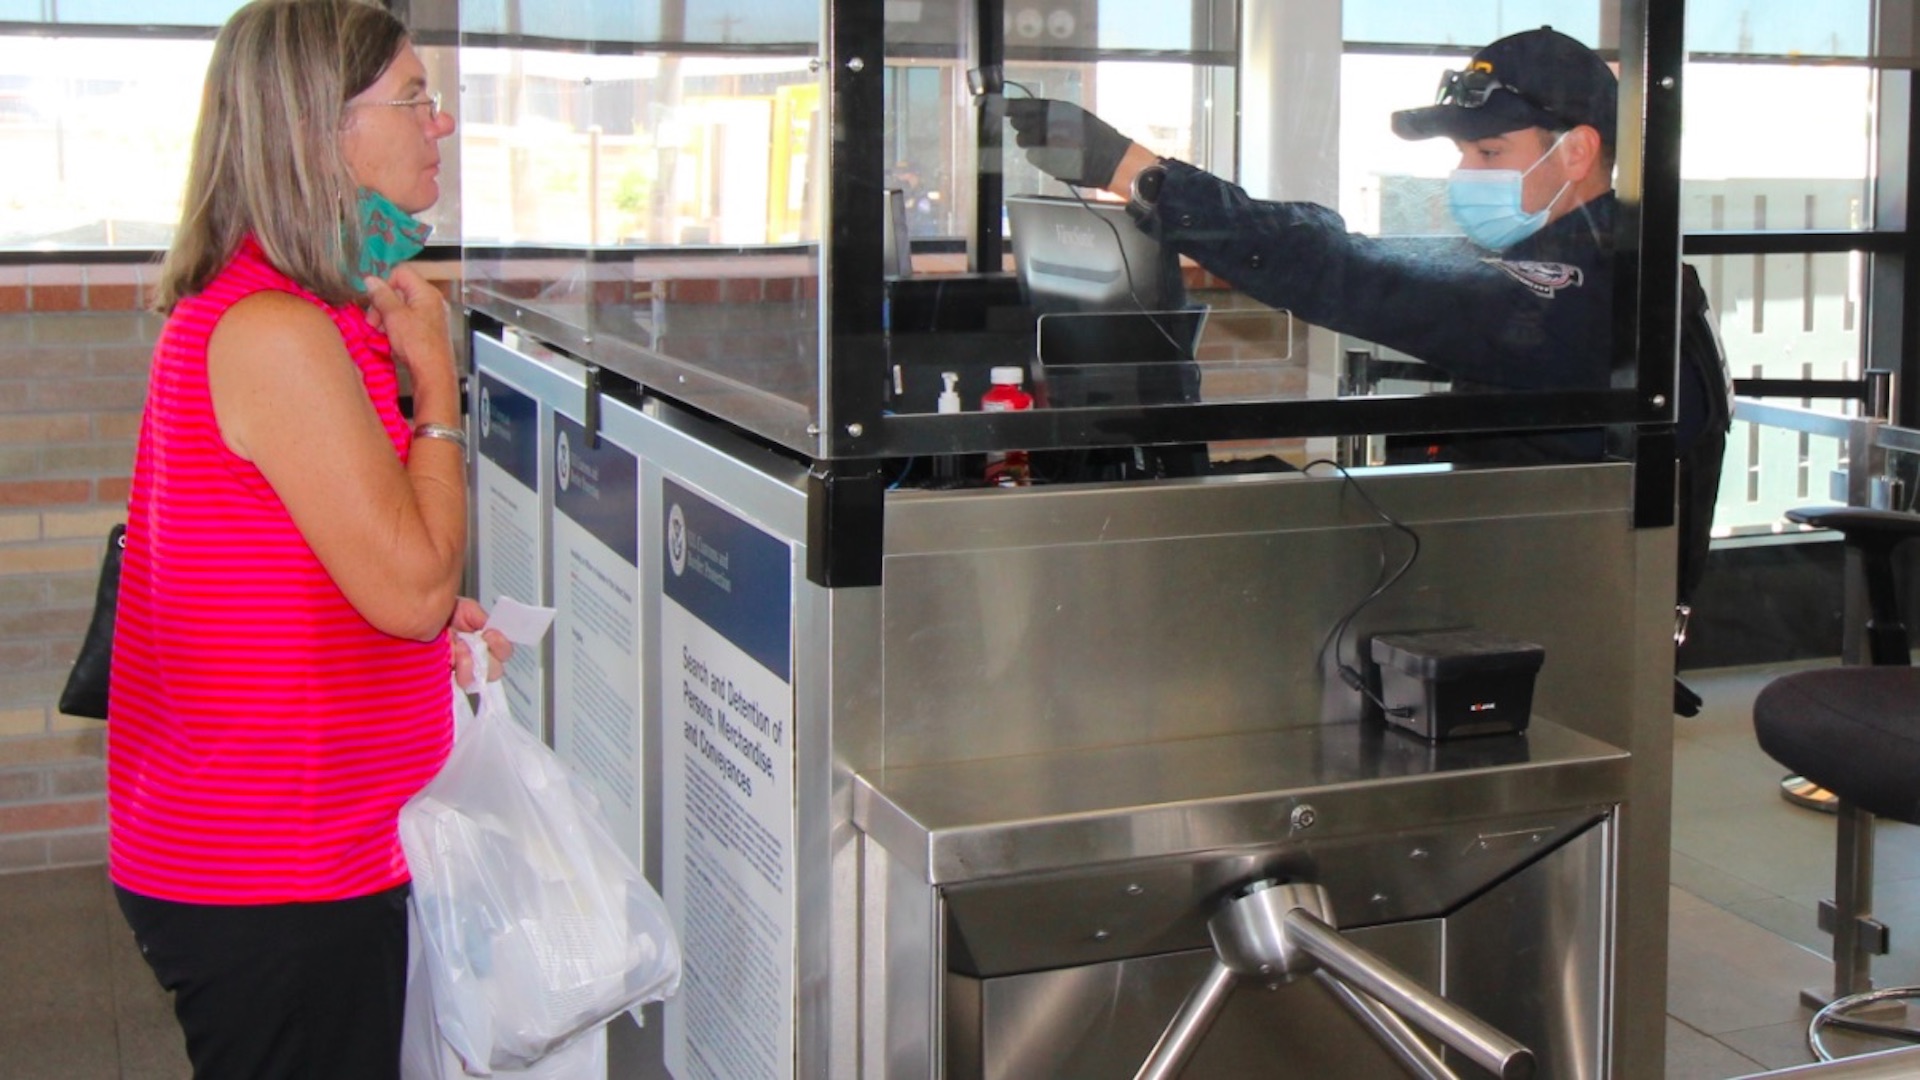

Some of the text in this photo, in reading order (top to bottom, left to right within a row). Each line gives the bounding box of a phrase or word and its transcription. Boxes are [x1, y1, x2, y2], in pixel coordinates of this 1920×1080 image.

[682, 644, 784, 747] Search and Detention of
[682, 679, 776, 787] Persons, Merchandise,
[683, 720, 753, 798] and Conveyances
